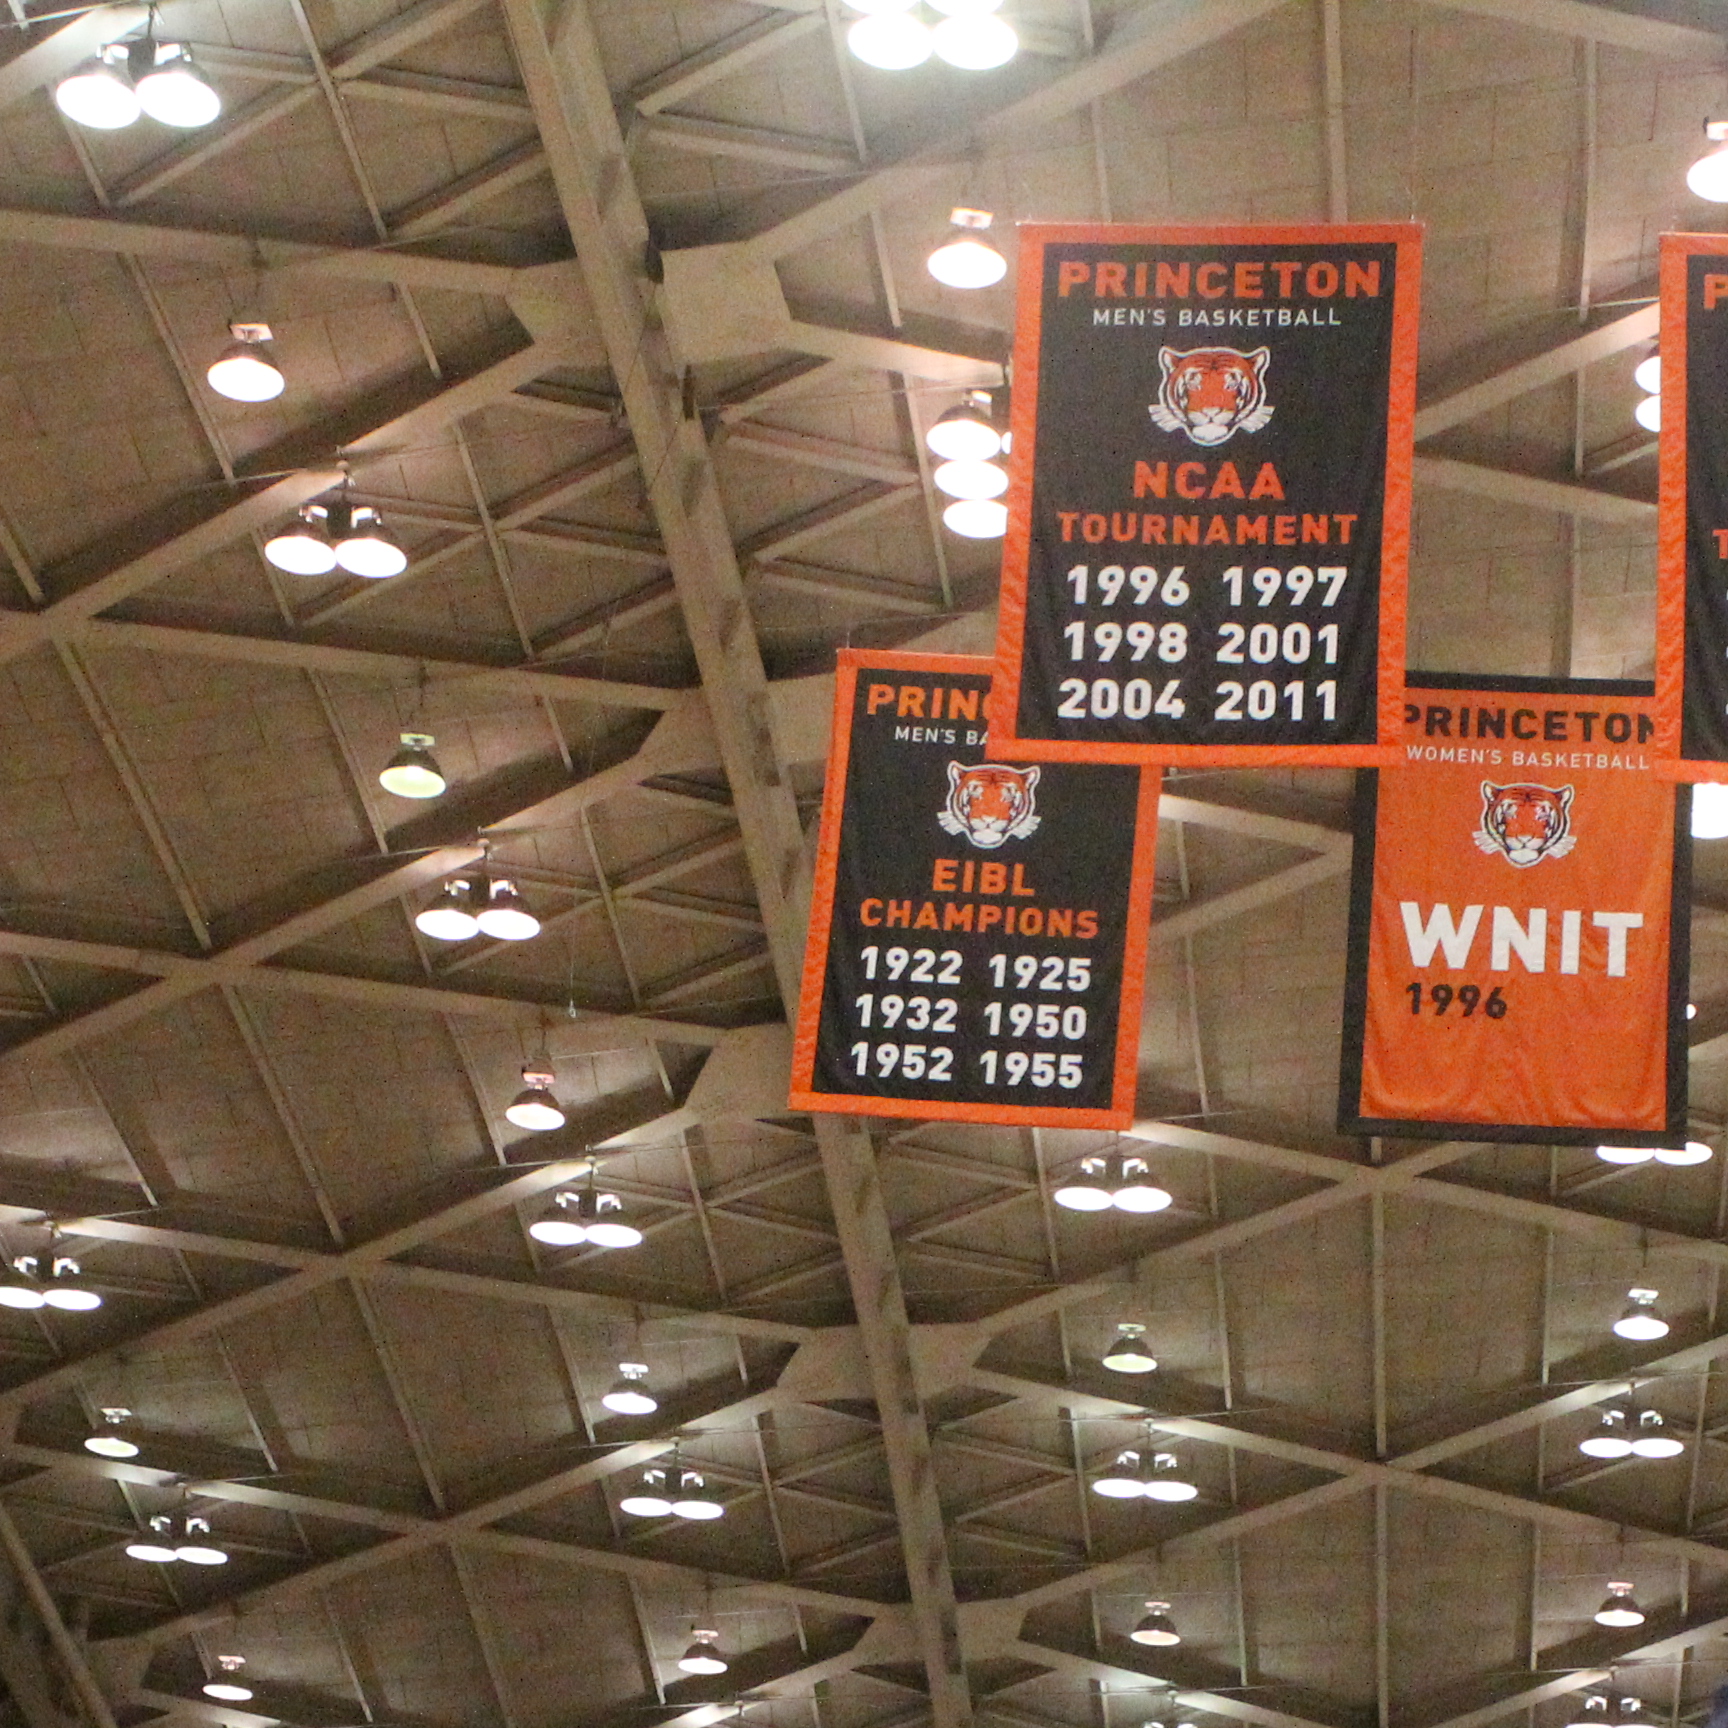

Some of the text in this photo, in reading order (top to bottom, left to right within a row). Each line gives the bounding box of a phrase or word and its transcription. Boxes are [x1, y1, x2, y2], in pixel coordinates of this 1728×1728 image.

[1057, 260, 1381, 299] PRINCETON
[1093, 307, 1342, 327] MEN'S BASKETBALL
[1133, 461, 1285, 501] NCAA
[1057, 511, 1357, 546] TOURNAMENT
[1067, 565, 1348, 607] 1996 1997
[1064, 622, 1339, 664] 1998 2001
[1057, 679, 1338, 722] 2004 2011
[895, 726, 956, 745] MEN'S
[1407, 745, 1650, 770] WOMEN'S BASKETBALL
[933, 858, 1035, 896] EIBL
[860, 898, 1098, 939] CHAMPIONS
[1400, 901, 1643, 977] WNIT
[860, 946, 1092, 991] 1922 1925
[855, 994, 1087, 1040] 1932 1950
[1406, 982, 1508, 1019] 1996
[851, 1042, 1083, 1089] 1952 1955
